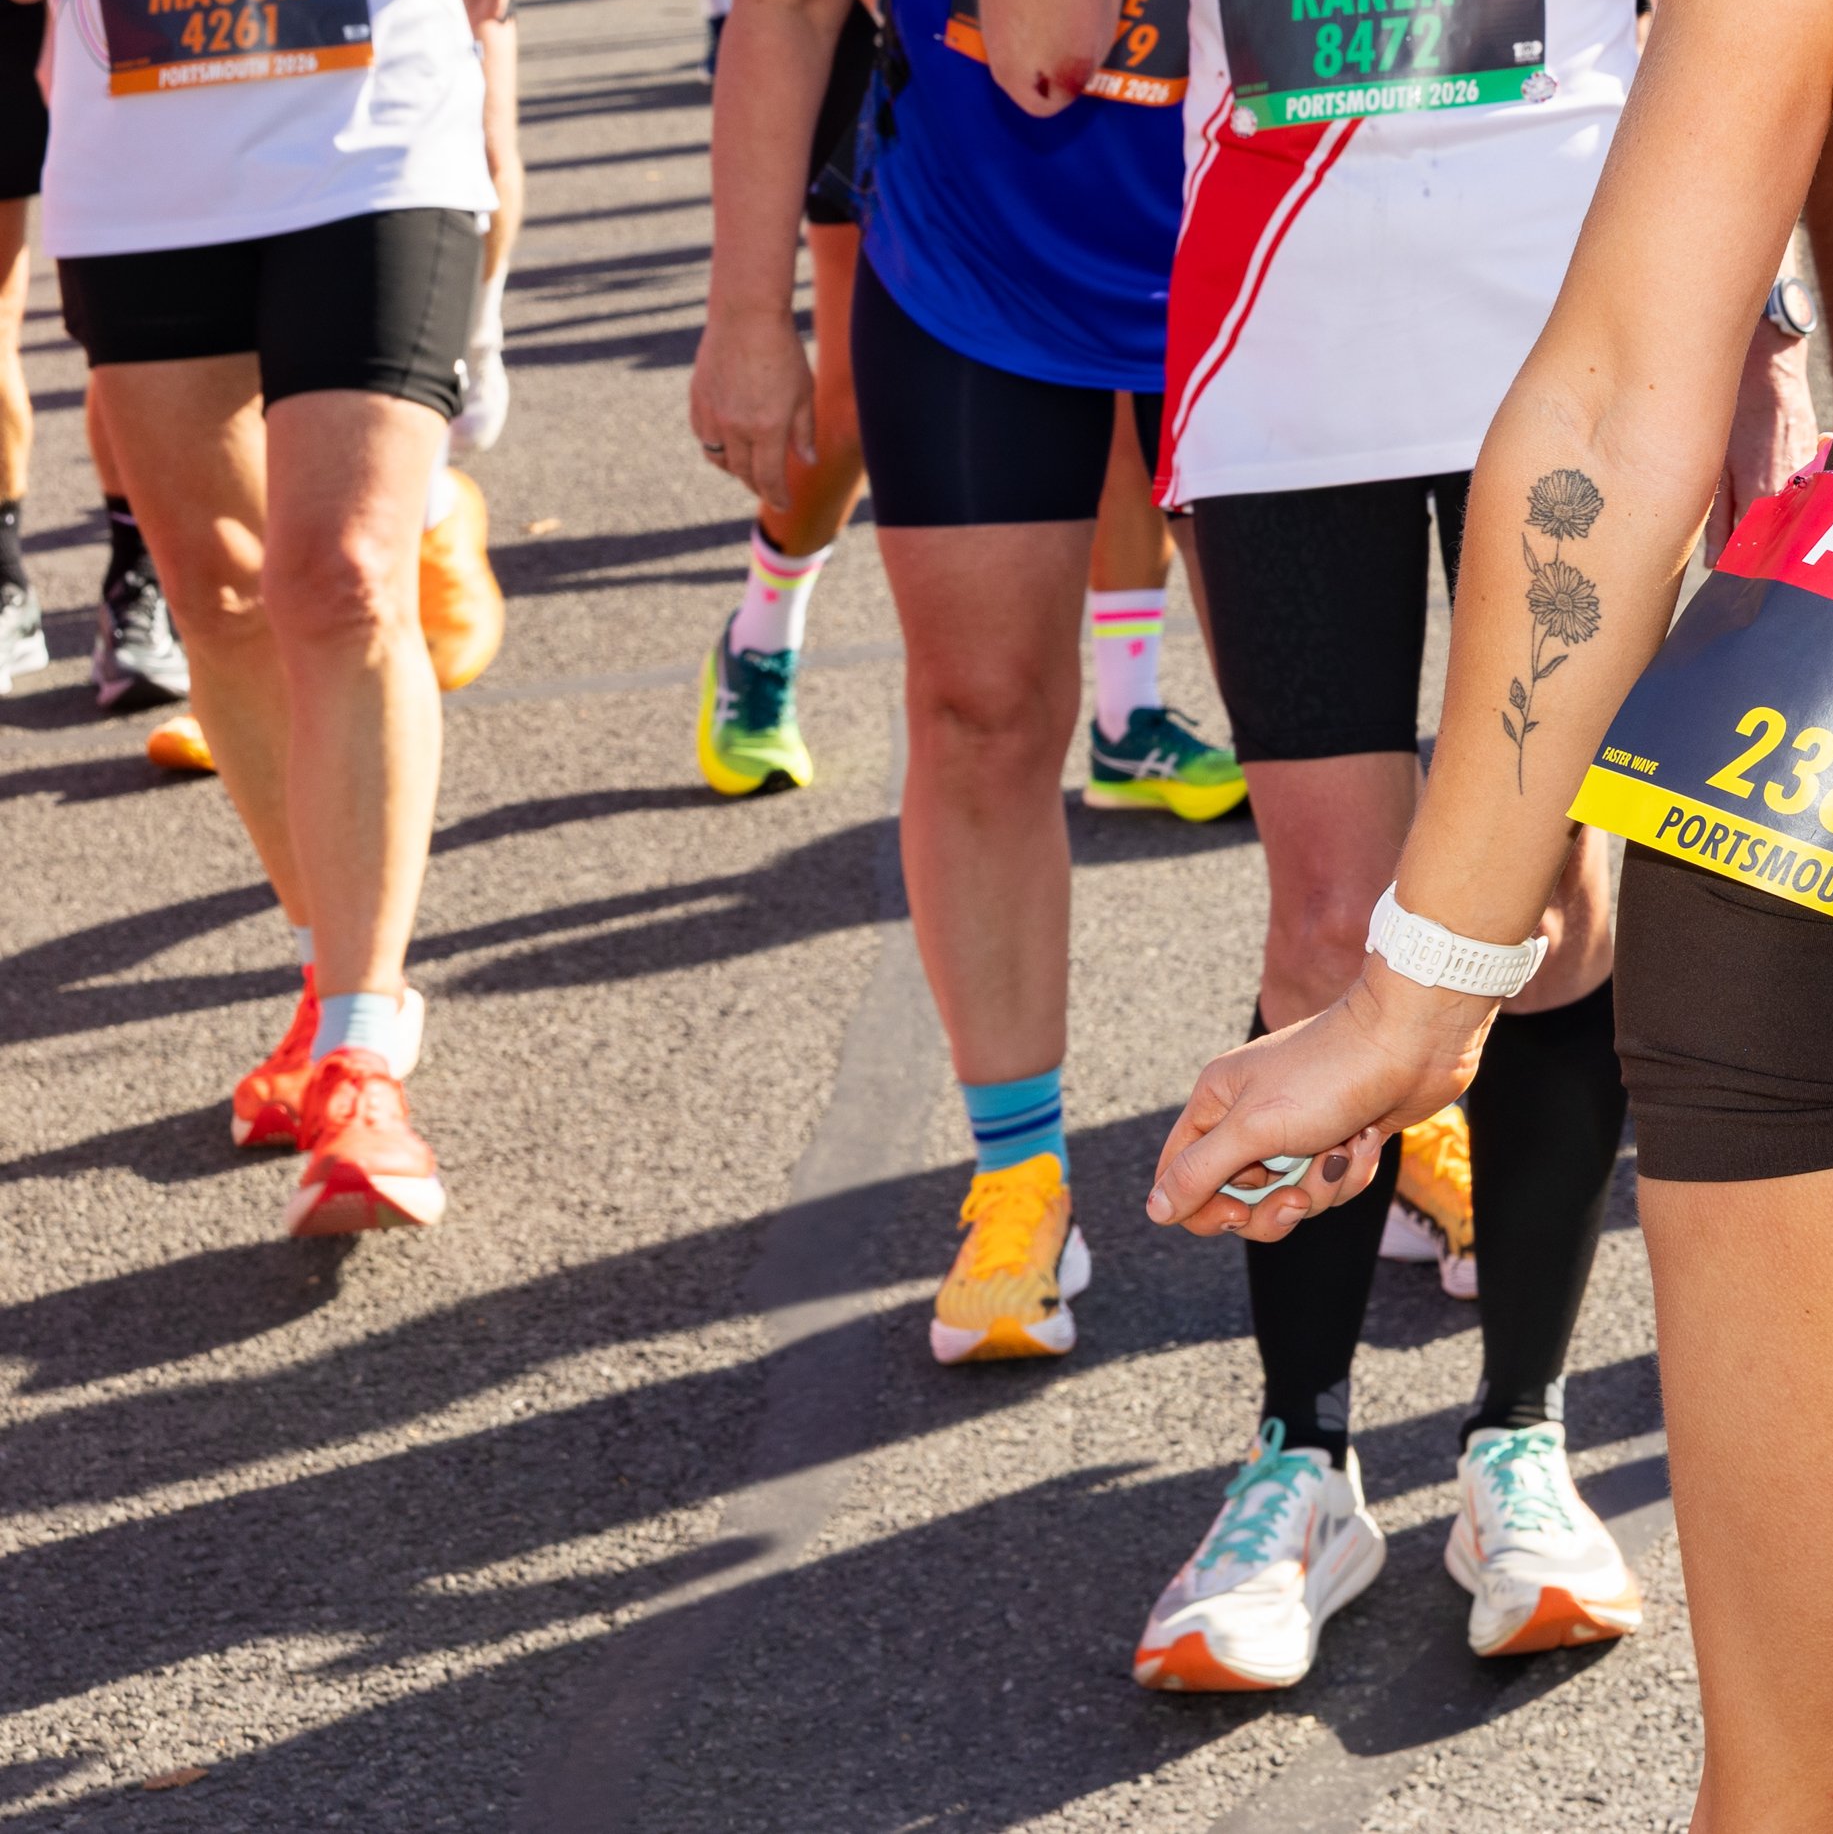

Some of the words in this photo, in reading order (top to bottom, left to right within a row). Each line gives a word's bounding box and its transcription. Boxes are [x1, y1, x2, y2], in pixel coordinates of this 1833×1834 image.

[181, 5, 279, 54] 4261
[1313, 14, 1443, 78] 8472
[158, 55, 270, 88] PORTSMOUTH
[273, 53, 319, 76] 2026
[1285, 83, 1422, 121] PORTSMOUTH
[1429, 79, 1480, 108] 2026
[1602, 746, 1633, 769] FASTER
[1630, 755, 1660, 776] WAVE
